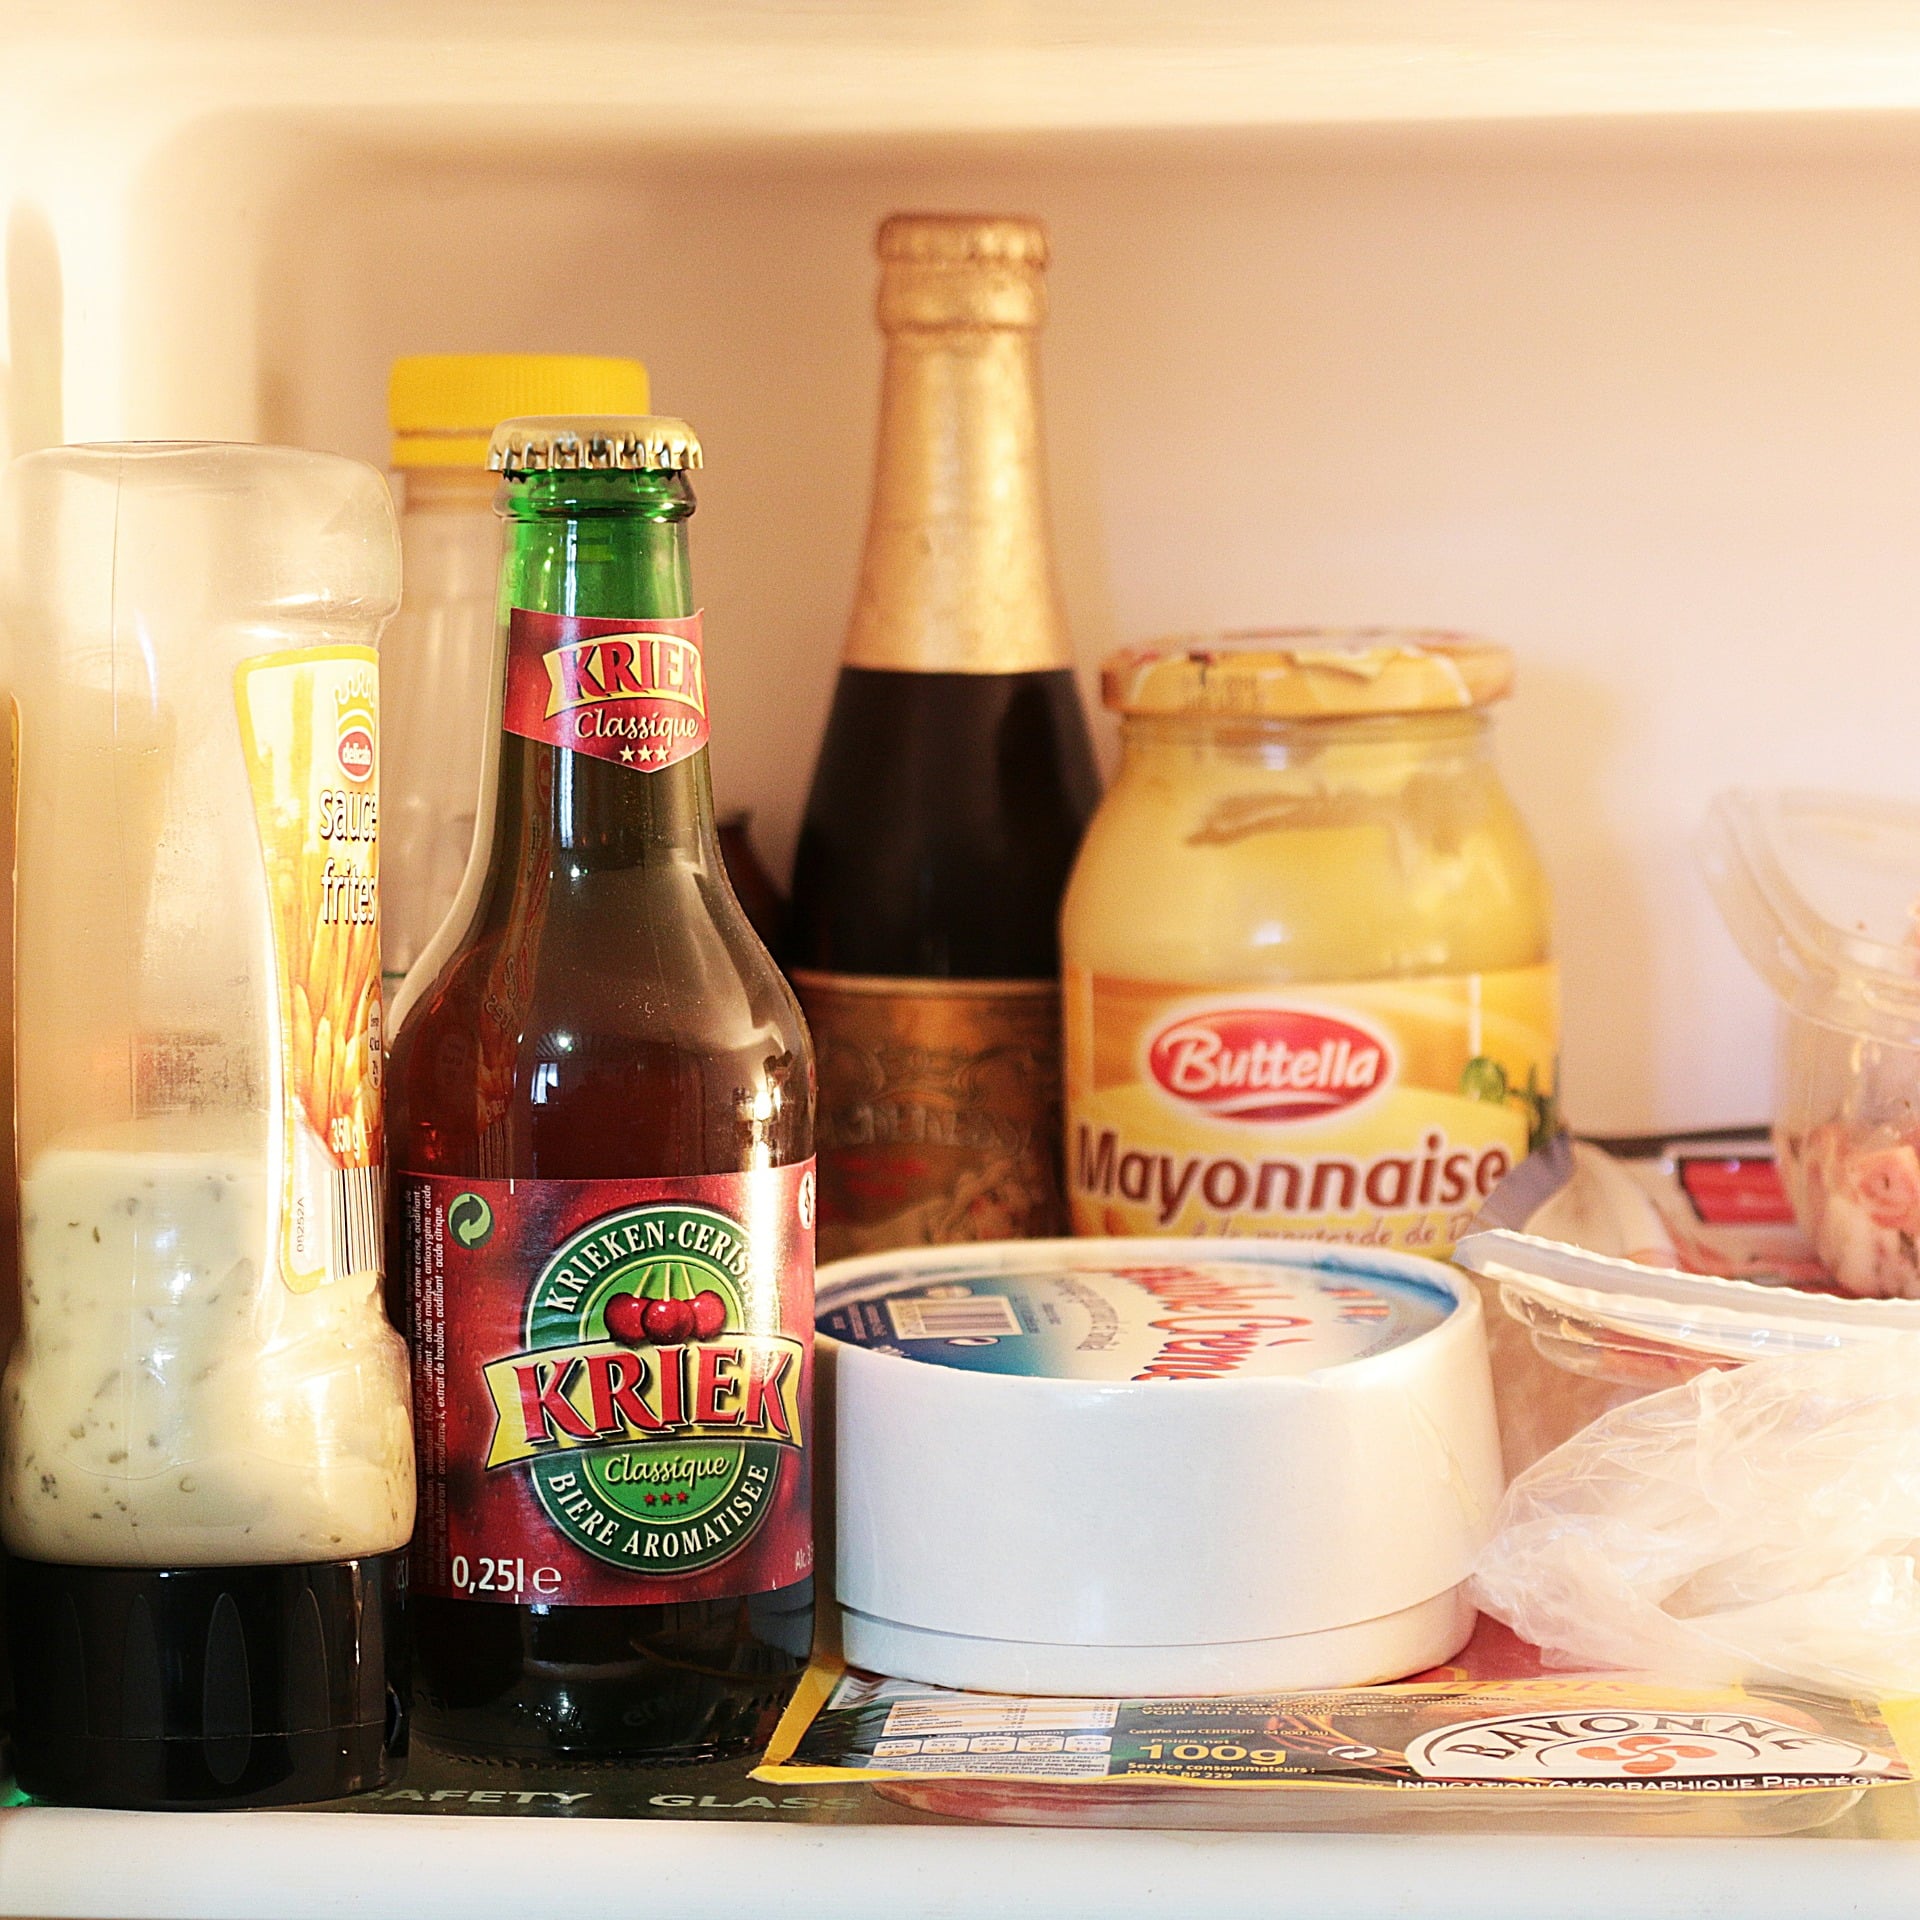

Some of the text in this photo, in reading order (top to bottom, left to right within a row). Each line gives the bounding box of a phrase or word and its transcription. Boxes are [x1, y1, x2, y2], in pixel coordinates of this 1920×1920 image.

[558, 639, 699, 705] KRIEK
[574, 708, 699, 747] Classique
[319, 790, 376, 842] sauce
[321, 857, 376, 924] frites
[1161, 1027, 1381, 1093] Buttella
[331, 1114, 351, 1153] 350
[352, 1122, 361, 1161] g
[1076, 1122, 1510, 1224] Mayonnaise
[411, 1191, 421, 1234] acidifiant
[421, 1185, 432, 1210] acide
[433, 1205, 445, 1242] citrique.
[412, 1236, 422, 1265] cerise,
[421, 1217, 433, 1275] antioxygène
[433, 1243, 444, 1268] acide
[422, 1277, 433, 1317] malique,
[433, 1275, 444, 1318] acidifiant
[412, 1300, 423, 1339] fructose,
[422, 1319, 432, 1343] acide
[433, 1320, 446, 1361] houblon,
[423, 1350, 433, 1392] acidifiant
[434, 1362, 445, 1375] de
[434, 1376, 445, 1408] extrait
[511, 1343, 797, 1445] KRIEK
[604, 1452, 732, 1487] Classique
[548, 1464, 769, 1558] BIERE AROMATISEE
[452, 1555, 524, 1594] 0,25l
[1139, 1744, 1288, 1766] 100g
[1444, 1717, 1827, 1761] BAYONNE
[1128, 1762, 1183, 1771] Service
[1186, 1765, 1308, 1774] consommateurs
[649, 1795, 861, 1809] GLASS
